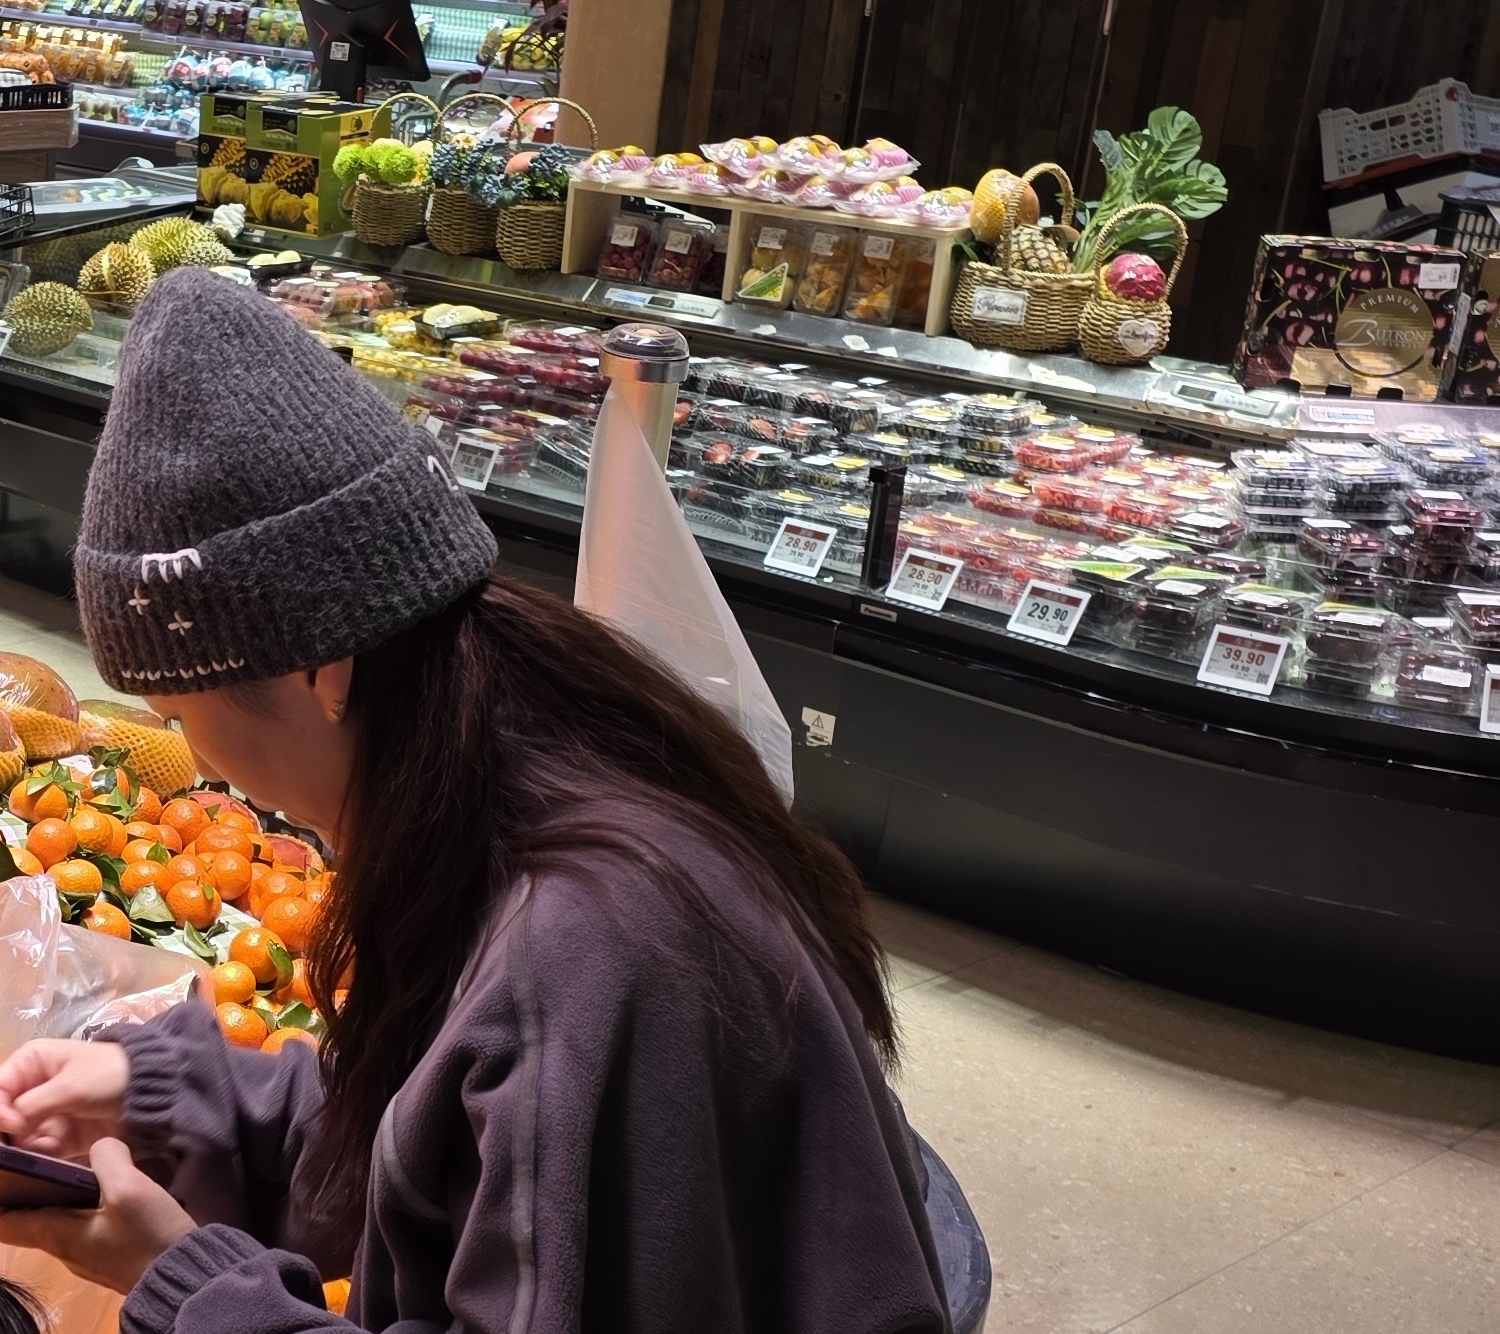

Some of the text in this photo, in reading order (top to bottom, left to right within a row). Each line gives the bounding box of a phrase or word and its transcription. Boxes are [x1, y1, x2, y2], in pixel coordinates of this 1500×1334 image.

[1360, 294, 1420, 314] PREMIUM
[785, 536, 818, 552] 28.90
[908, 568, 943, 585] 28.90
[1027, 602, 1068, 622] 29.90
[1222, 647, 1266, 666] 39.90
